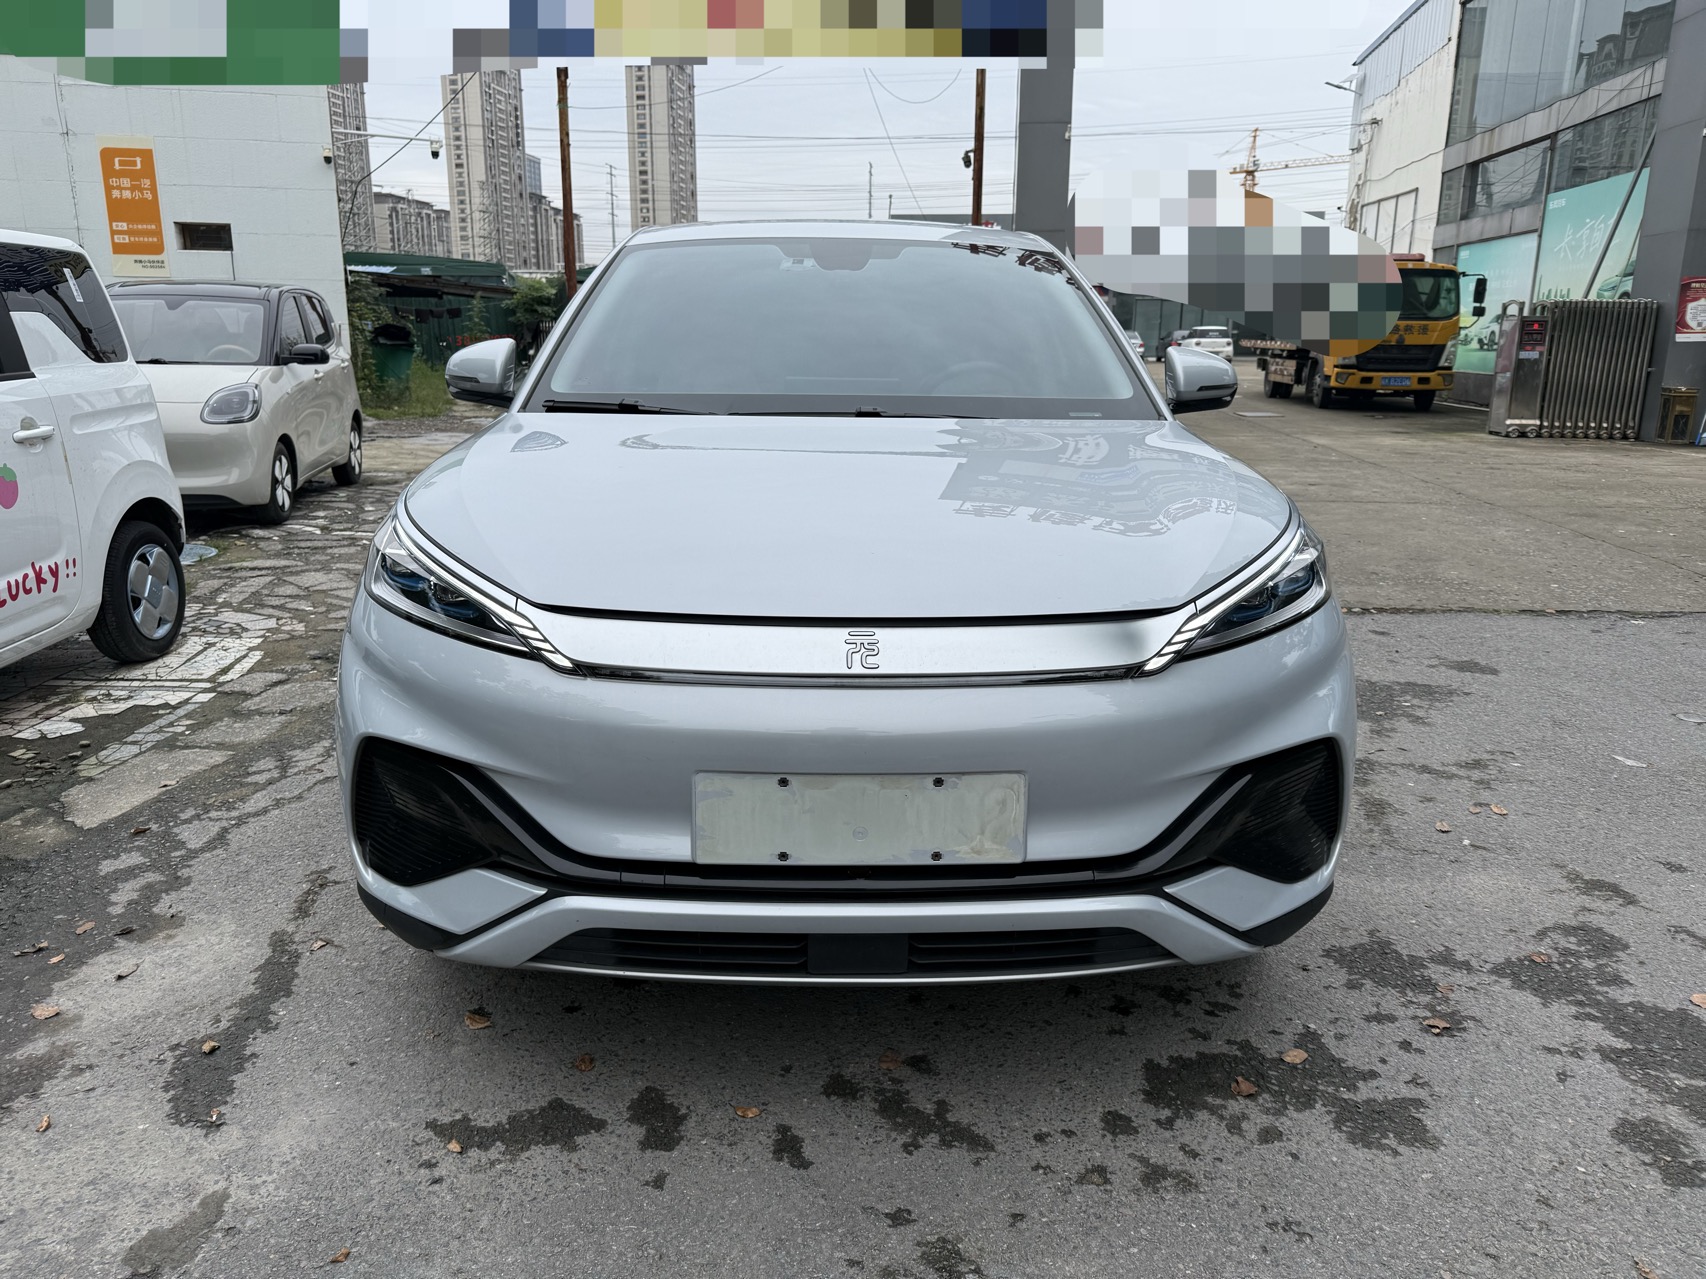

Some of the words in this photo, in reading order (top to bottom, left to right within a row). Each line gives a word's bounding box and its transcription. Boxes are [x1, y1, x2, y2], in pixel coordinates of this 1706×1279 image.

[109, 178, 151, 188] 中国一汽
[111, 189, 153, 200] 奔腾小马
